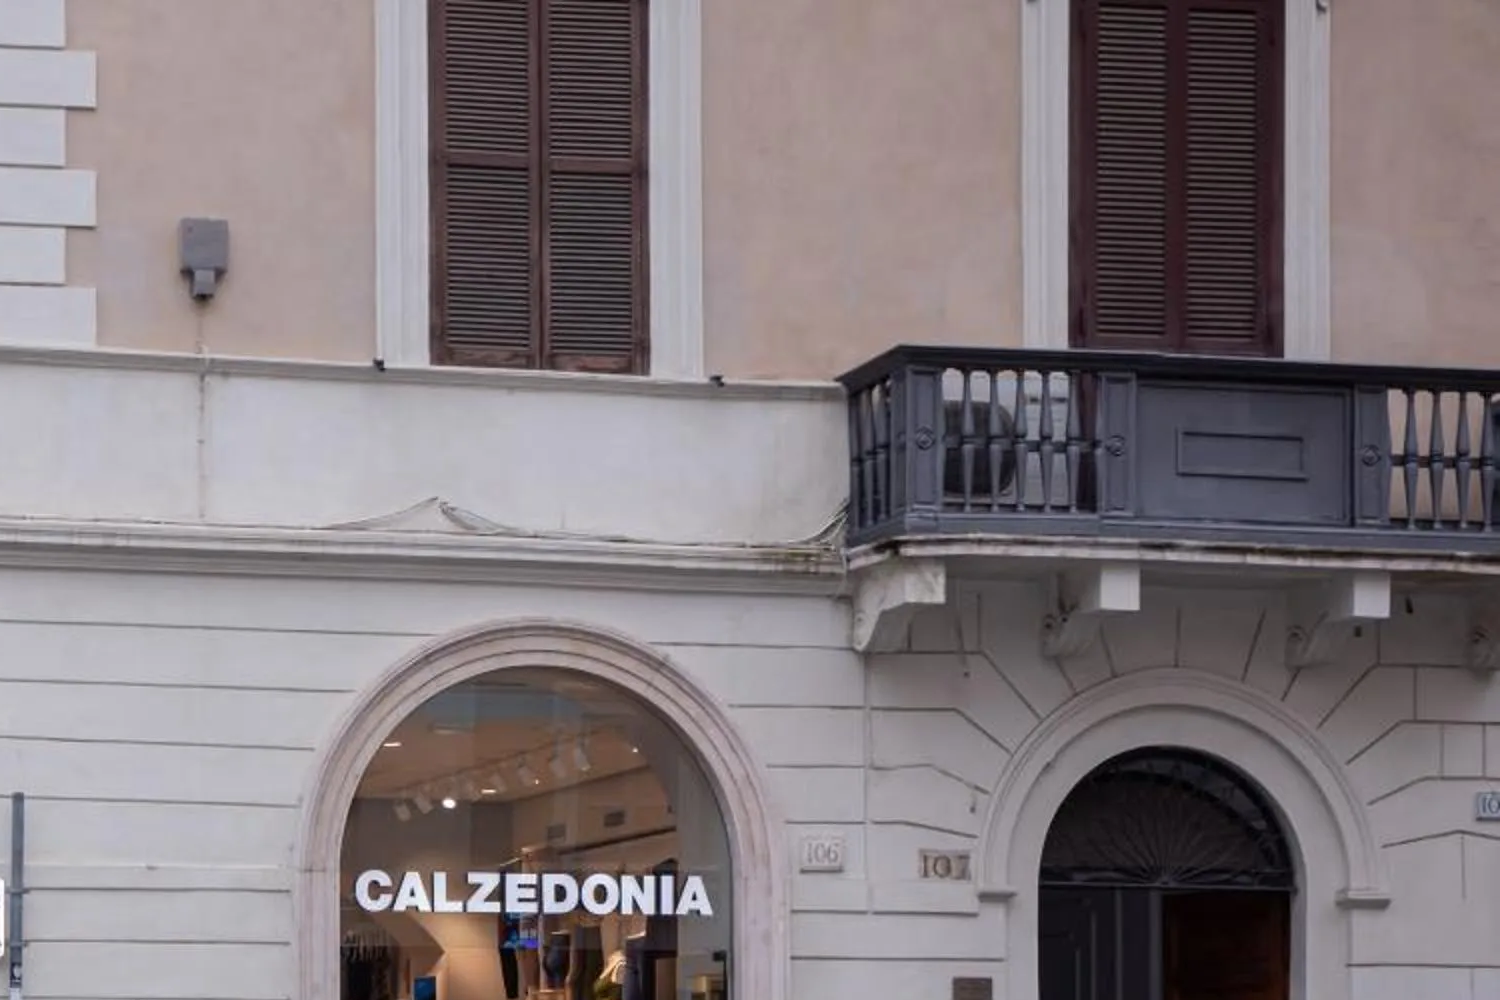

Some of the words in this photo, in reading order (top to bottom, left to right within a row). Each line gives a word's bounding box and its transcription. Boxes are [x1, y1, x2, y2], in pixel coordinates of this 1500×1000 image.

[1482, 797, 1500, 814] 10
[807, 842, 839, 863] 106
[921, 854, 971, 880] 107
[355, 870, 713, 916] CALZEDONIA
